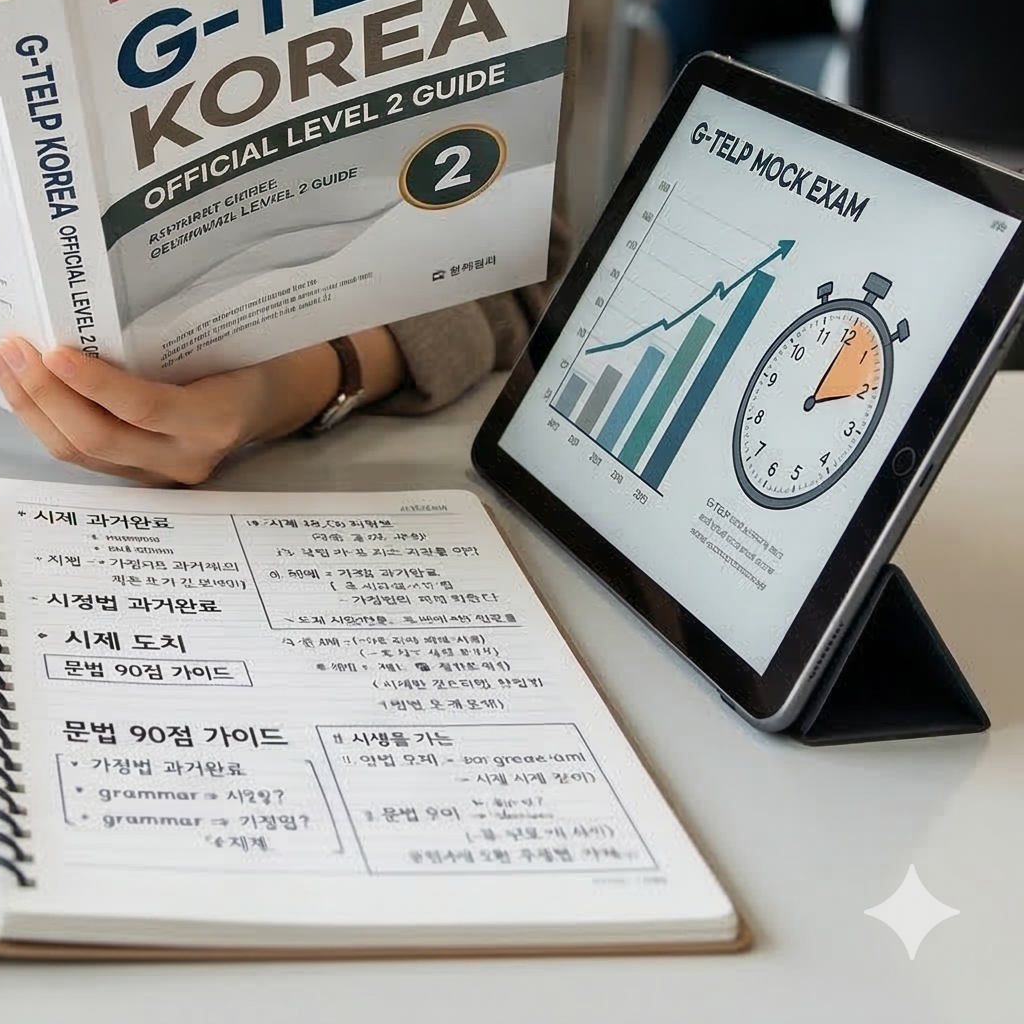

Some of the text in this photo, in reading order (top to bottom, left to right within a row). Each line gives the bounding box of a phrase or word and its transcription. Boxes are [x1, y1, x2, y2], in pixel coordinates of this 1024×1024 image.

[15, 34, 63, 132] G-TELP
[144, 63, 506, 211] OFFICIAL LEVEL 2 GUIDE
[434, 144, 471, 193] 2
[690, 122, 872, 222] G-TELP MOCK EXAM
[34, 135, 80, 221] KOREA
[298, 183, 308, 195] 2
[311, 167, 358, 190] GUIDE
[59, 224, 83, 289] OFFICIAL
[71, 291, 95, 334] LEVEL
[80, 336, 97, 345] 2
[816, 328, 831, 345] 11
[840, 328, 857, 346] 12
[791, 343, 805, 361] 10
[860, 350, 868, 365] 1
[767, 372, 778, 387] 9
[856, 383, 870, 400] 2
[754, 409, 765, 425] 8
[844, 421, 856, 437] 3
[754, 440, 767, 457] 7
[819, 451, 831, 467] 4
[767, 462, 778, 477] 6
[790, 465, 803, 481] 5
[34, 510, 175, 530] 시제 과거완료
[47, 593, 222, 615] 시정법 과거완료
[65, 630, 187, 654] 시제 도치
[114, 664, 164, 681] 90점
[171, 665, 235, 681] 가이드
[63, 720, 289, 748] 문법 90점 가이드
[91, 758, 153, 776] 가정법
[98, 788, 198, 803] grammar
[103, 813, 202, 829] grammar
